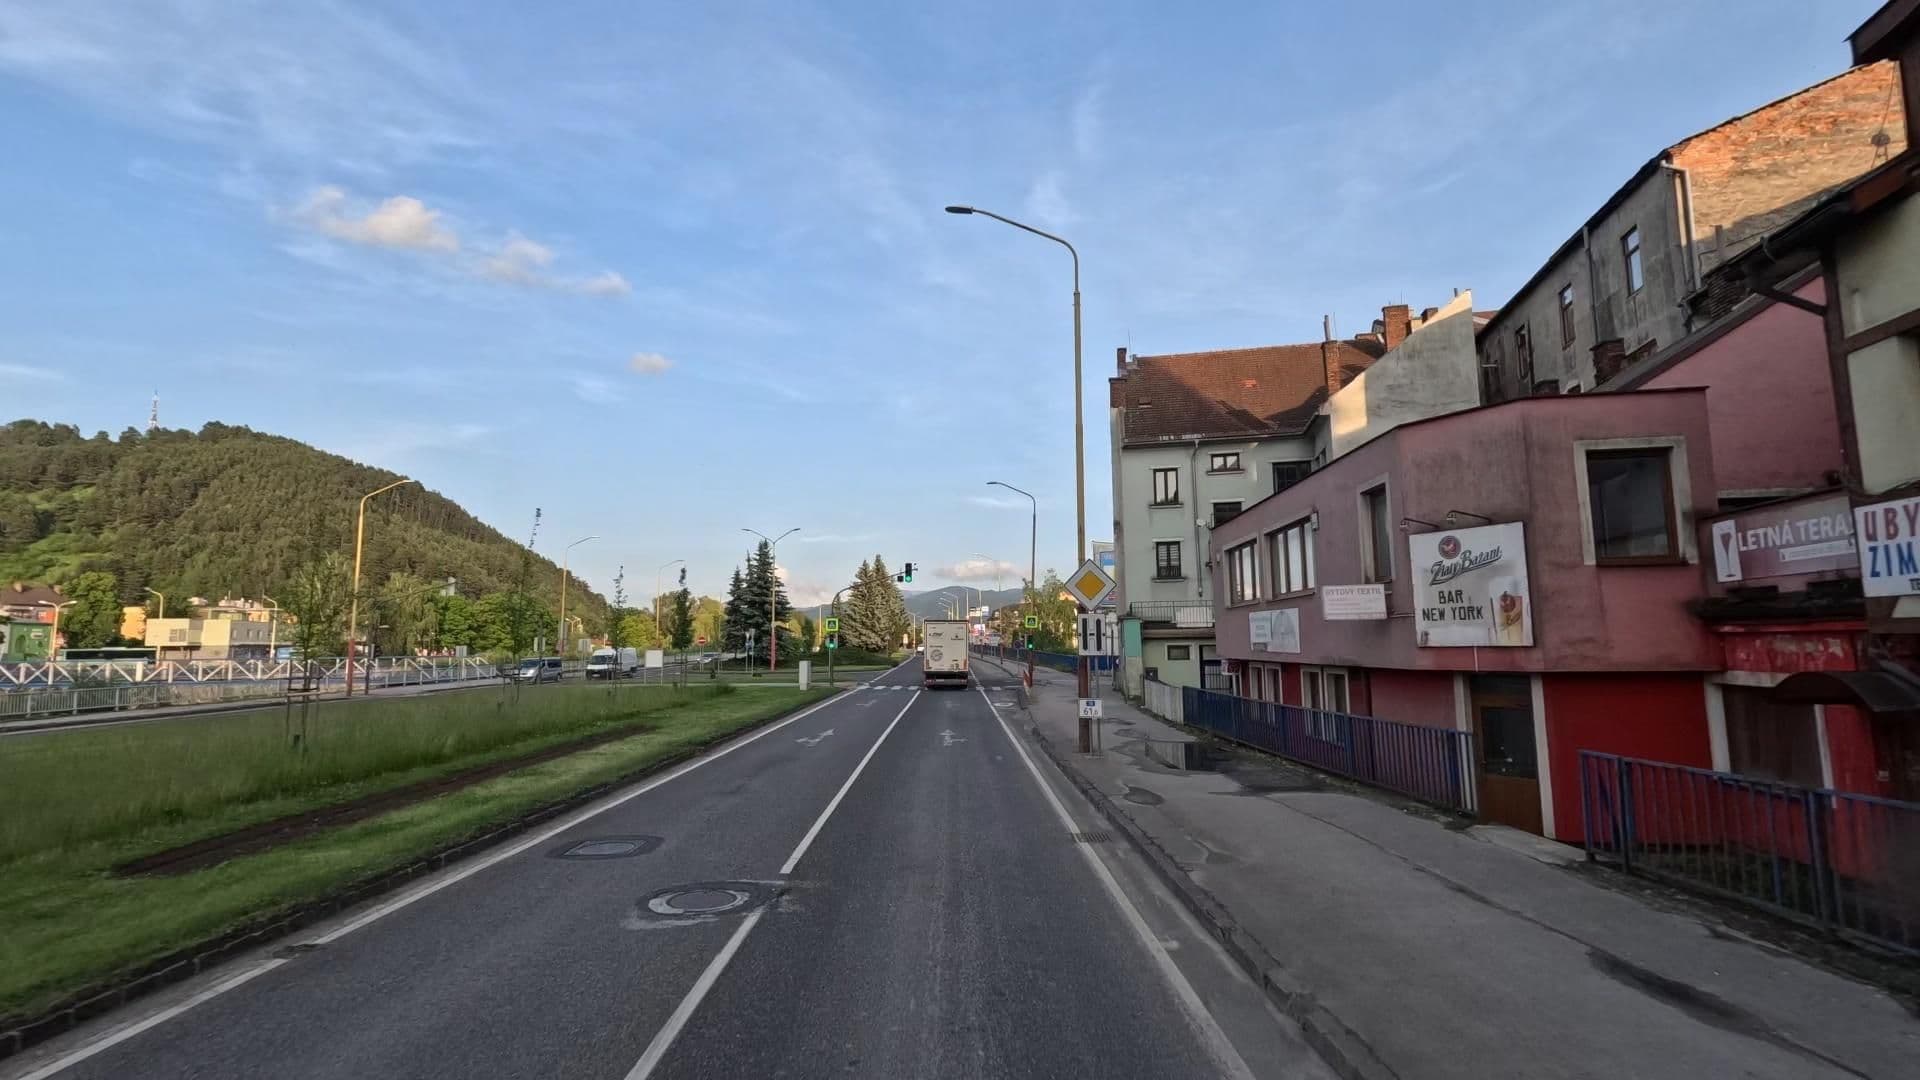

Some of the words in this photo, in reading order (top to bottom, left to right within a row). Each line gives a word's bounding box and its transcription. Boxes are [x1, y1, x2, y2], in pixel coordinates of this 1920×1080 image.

[1737, 520, 1795, 551] LETNÁ
[1438, 590, 1464, 604] BAR
[1422, 608, 1446, 622] NEW
[1450, 606, 1484, 621] YORK
